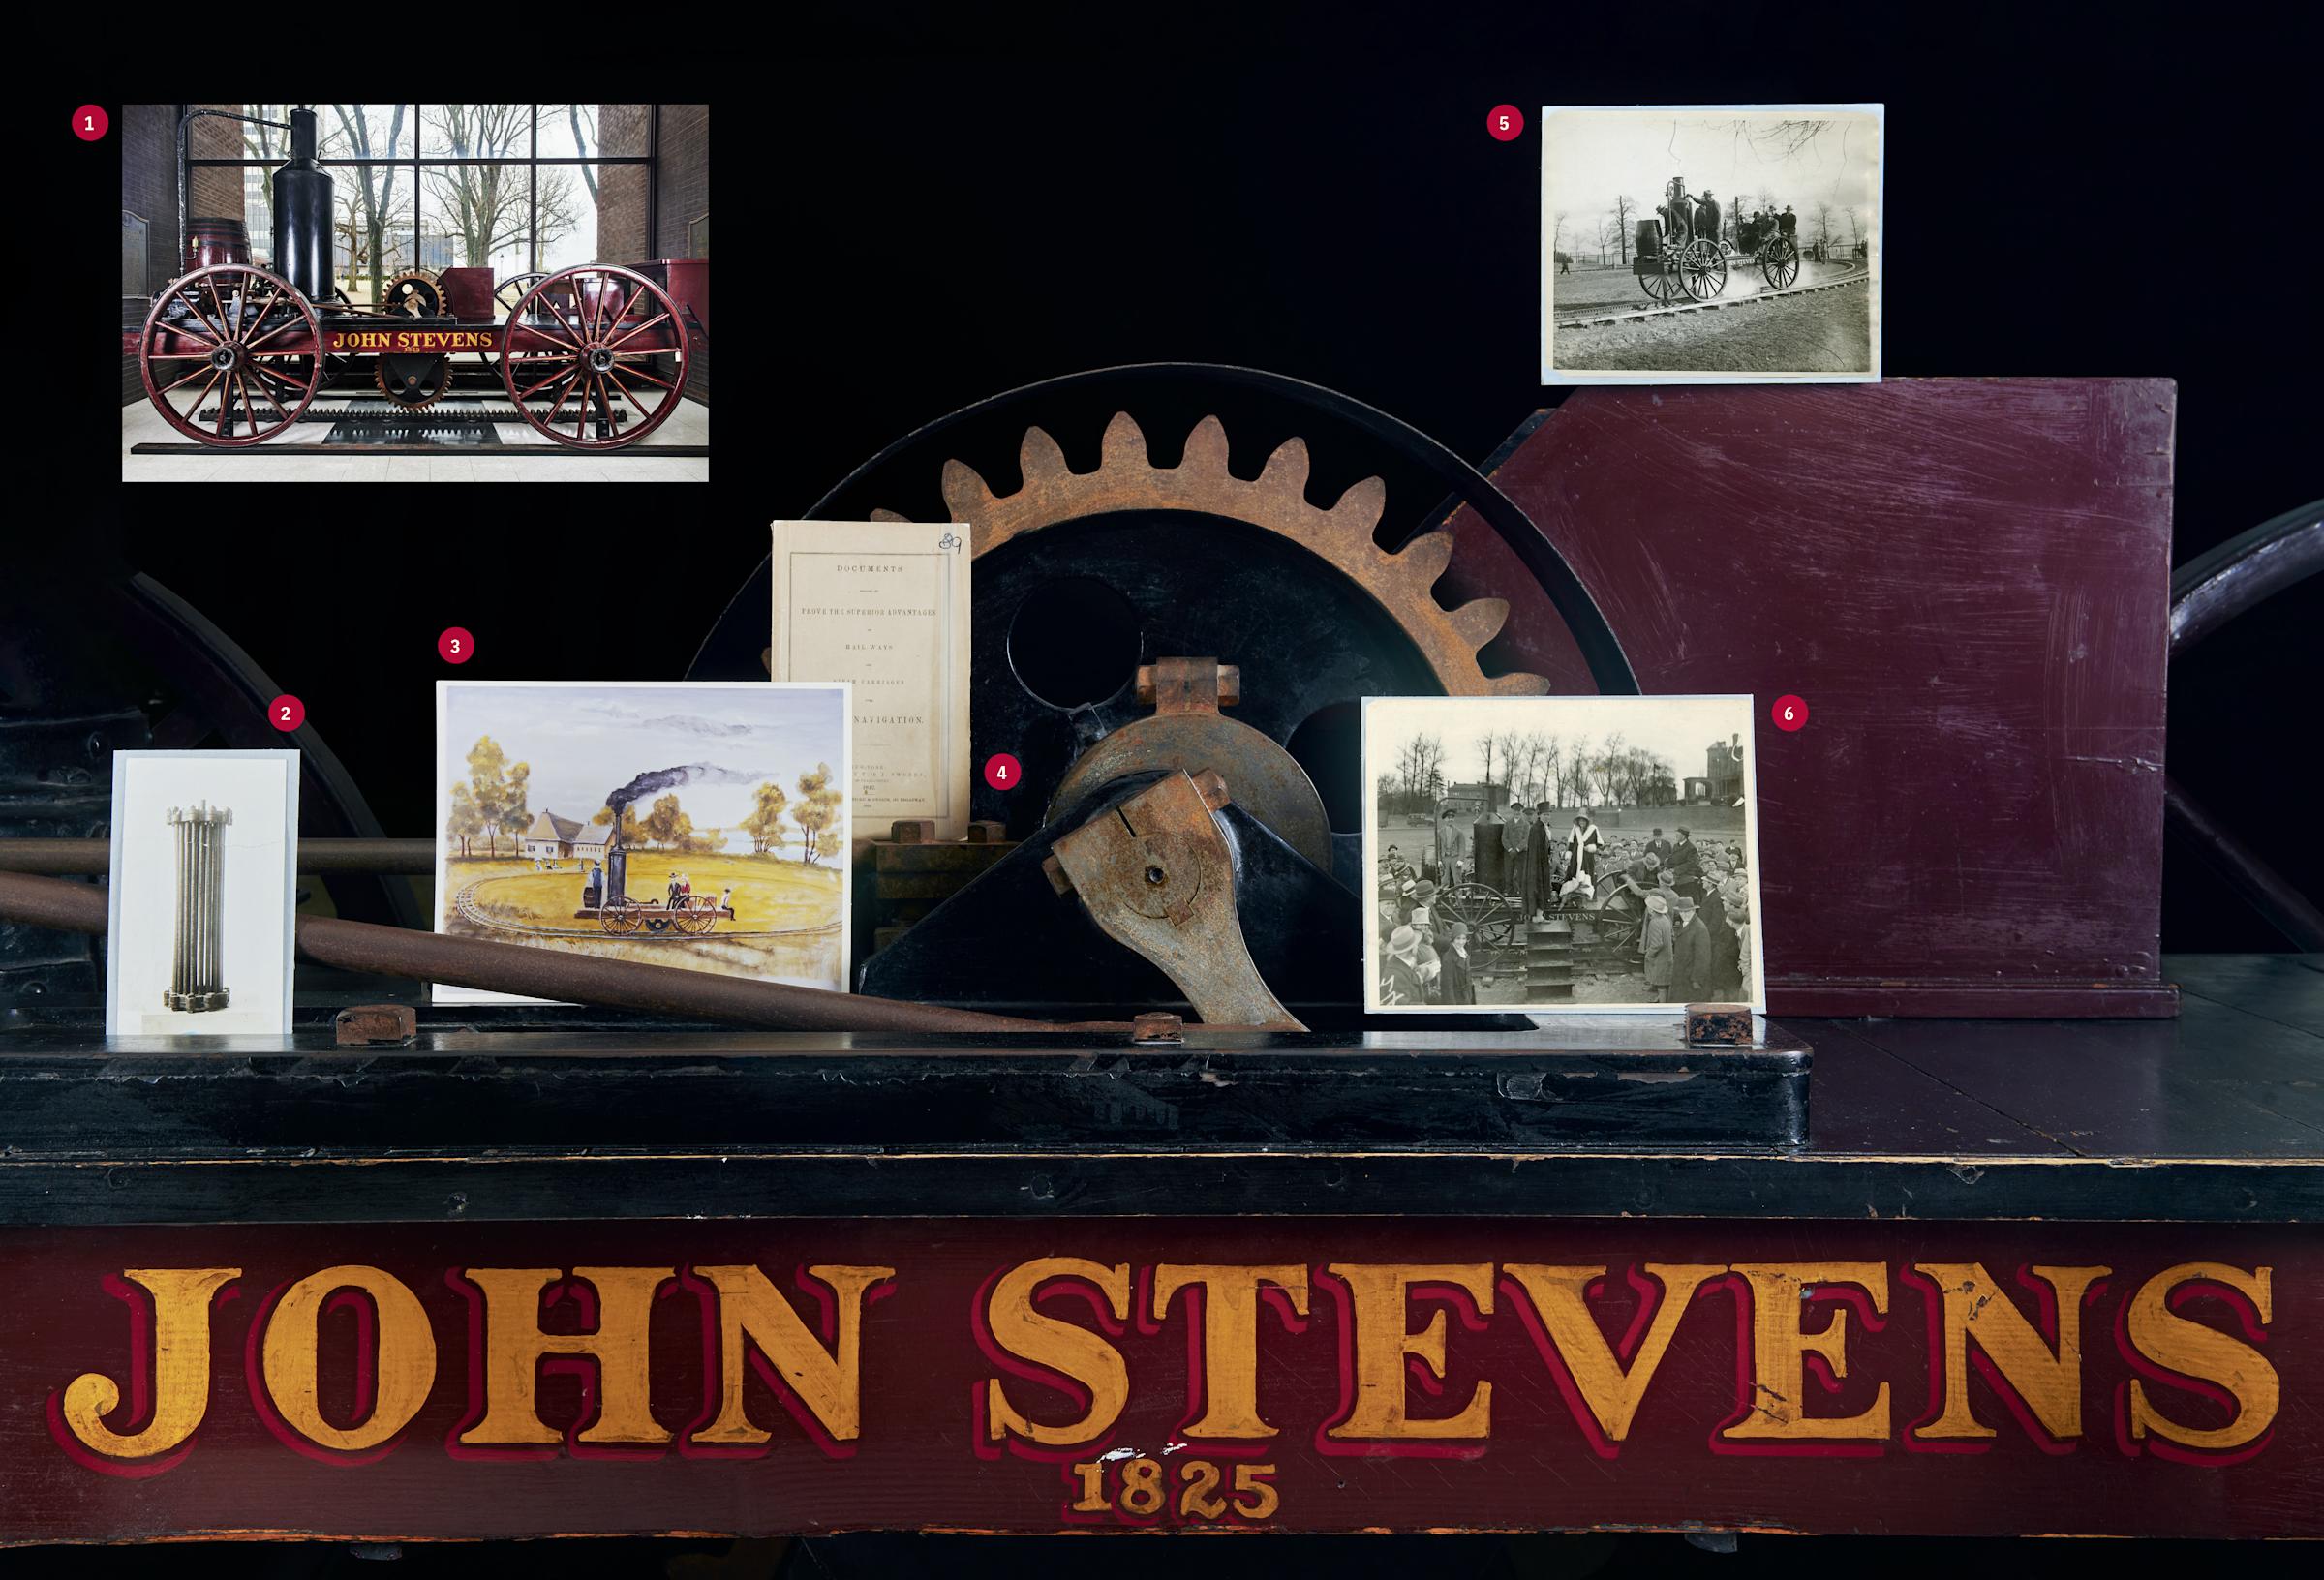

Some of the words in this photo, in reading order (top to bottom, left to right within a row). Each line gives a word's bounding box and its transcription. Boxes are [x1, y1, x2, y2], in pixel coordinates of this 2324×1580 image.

[332, 332, 392, 348] JOHN
[397, 332, 493, 348] STEVENS
[837, 564, 902, 573] DOCUMENTS
[829, 607, 844, 616] THE
[887, 608, 936, 617] ADVANTAGES
[63, 1264, 896, 1459] JOHN
[986, 1257, 2281, 1448] STEVENS
[1073, 1458, 1279, 1519] 1825
